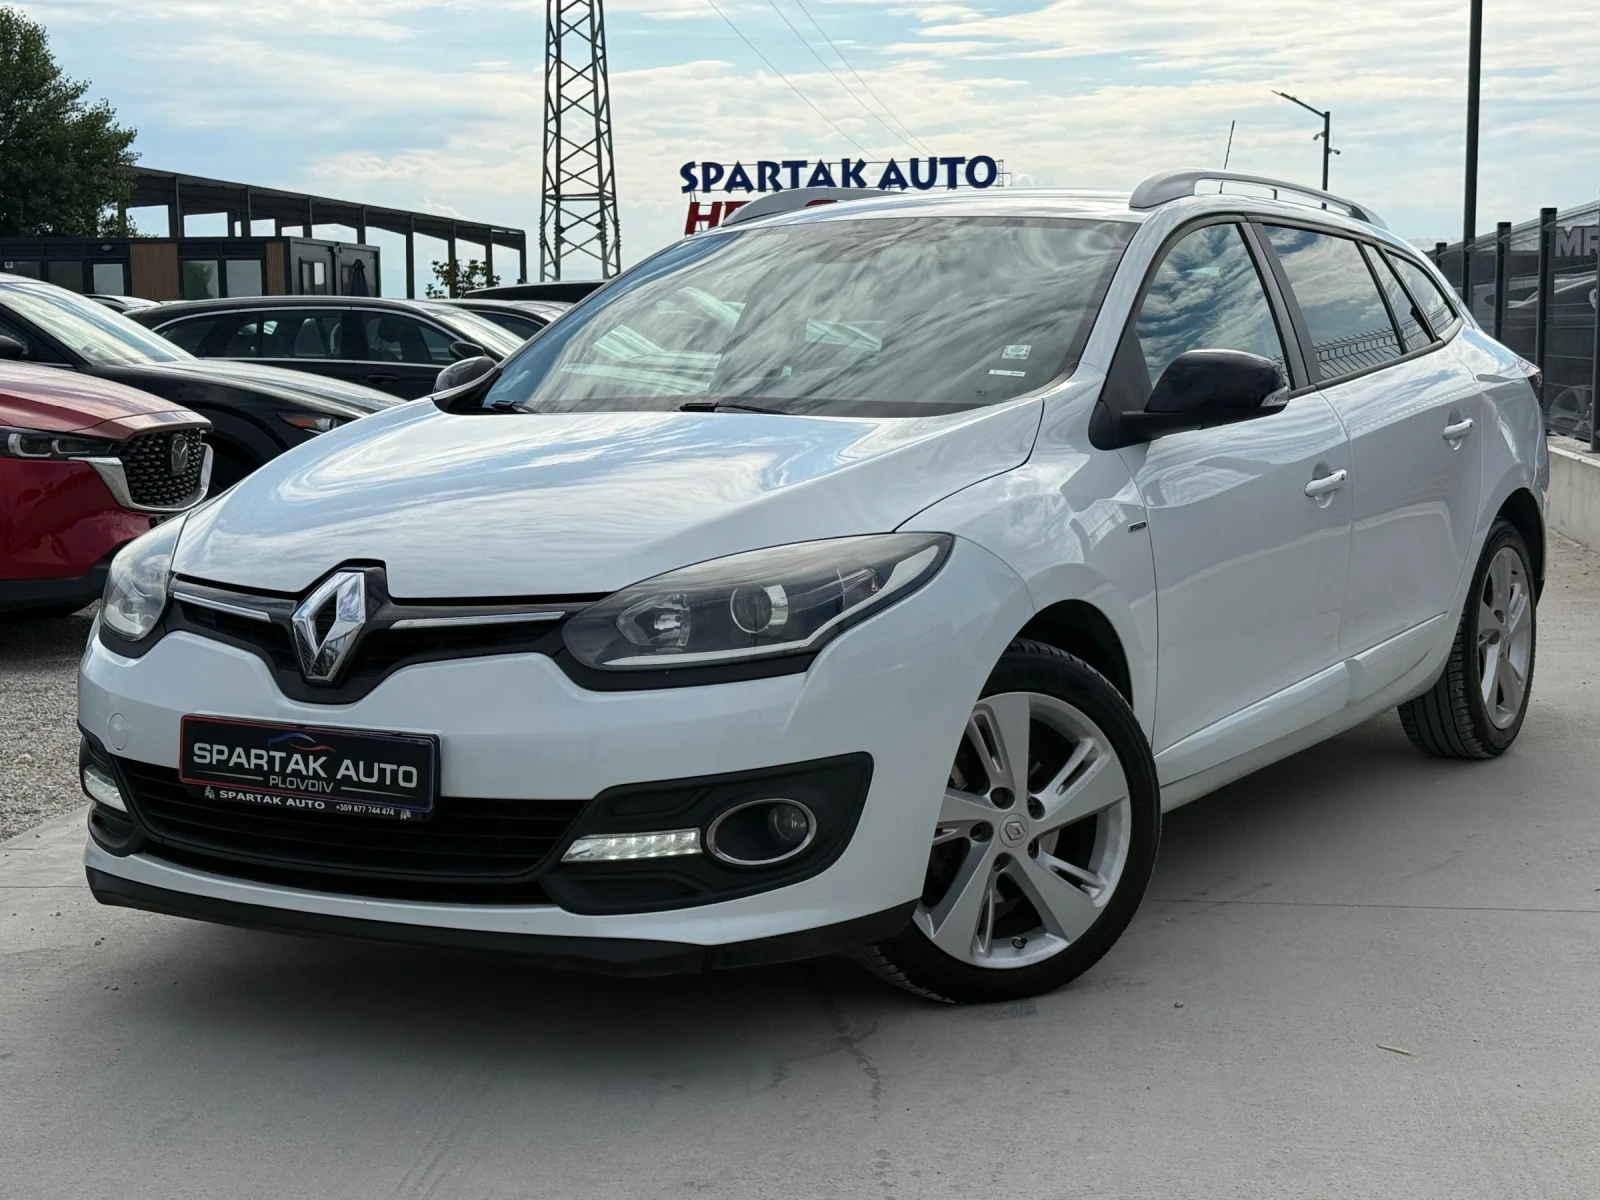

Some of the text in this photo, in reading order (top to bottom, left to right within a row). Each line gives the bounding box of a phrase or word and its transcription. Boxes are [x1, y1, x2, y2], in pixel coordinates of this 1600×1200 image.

[680, 155, 997, 194] SPARTAK AUTO
[193, 742, 418, 788] SPARTAK AUTO
[269, 775, 334, 793] PLOVDIV
[219, 790, 325, 809] SPARTAK AUTO
[336, 803, 395, 816] +359 877 744 474
